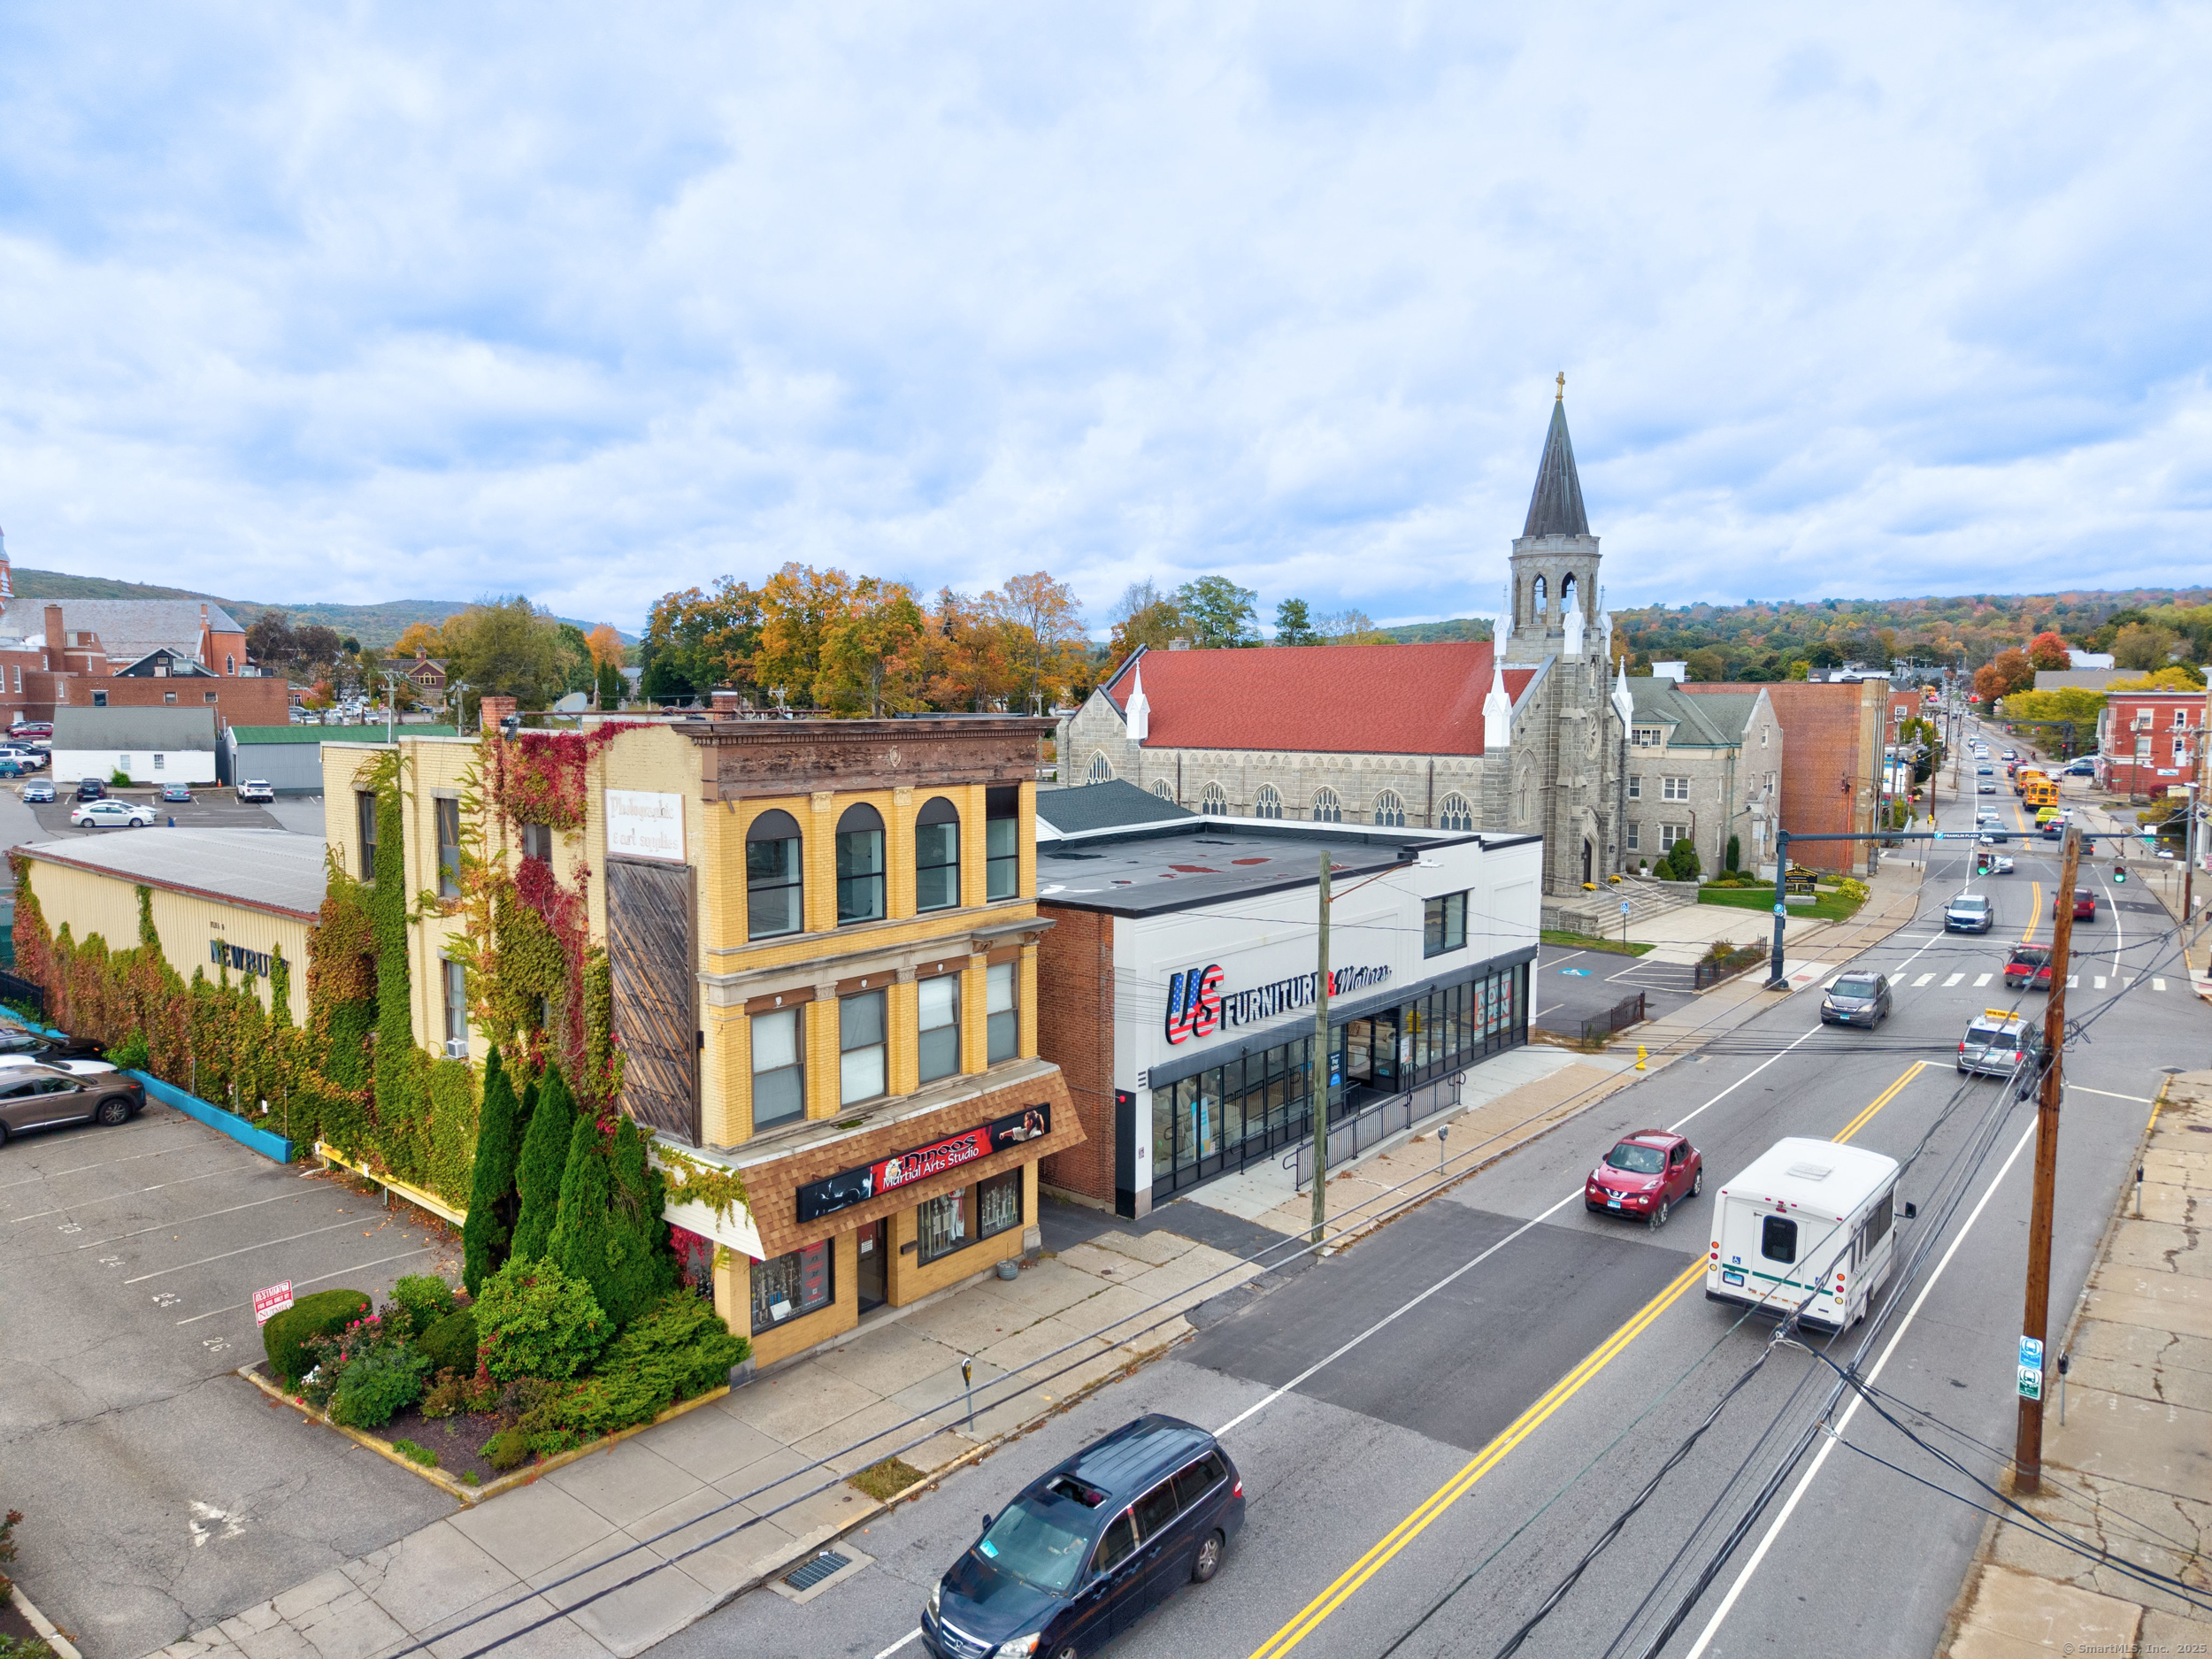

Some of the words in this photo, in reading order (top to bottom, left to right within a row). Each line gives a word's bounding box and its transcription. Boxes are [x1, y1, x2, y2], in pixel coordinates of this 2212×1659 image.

[619, 827, 636, 846] art
[640, 831, 679, 853] supplies
[1165, 964, 1225, 1045] US
[1334, 964, 1392, 996] Mattress
[882, 1165, 921, 1190] Martial
[922, 1159, 945, 1176] Arts
[948, 1147, 979, 1166] Studio
